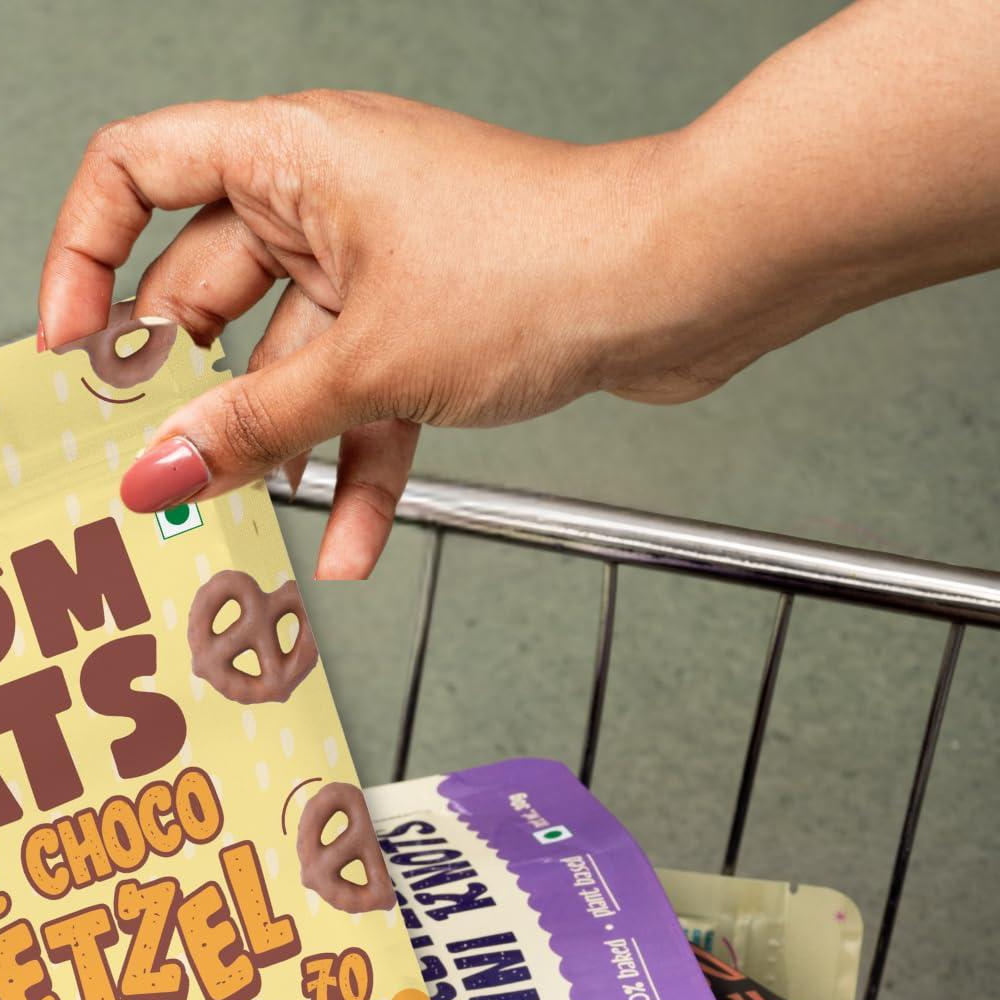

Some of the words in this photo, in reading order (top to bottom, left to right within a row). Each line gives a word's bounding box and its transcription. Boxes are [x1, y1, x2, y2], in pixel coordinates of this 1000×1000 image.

[20, 767, 224, 900] CHOCO
[560, 856, 596, 887] based
[579, 890, 617, 919] plant
[603, 939, 639, 979] baked
